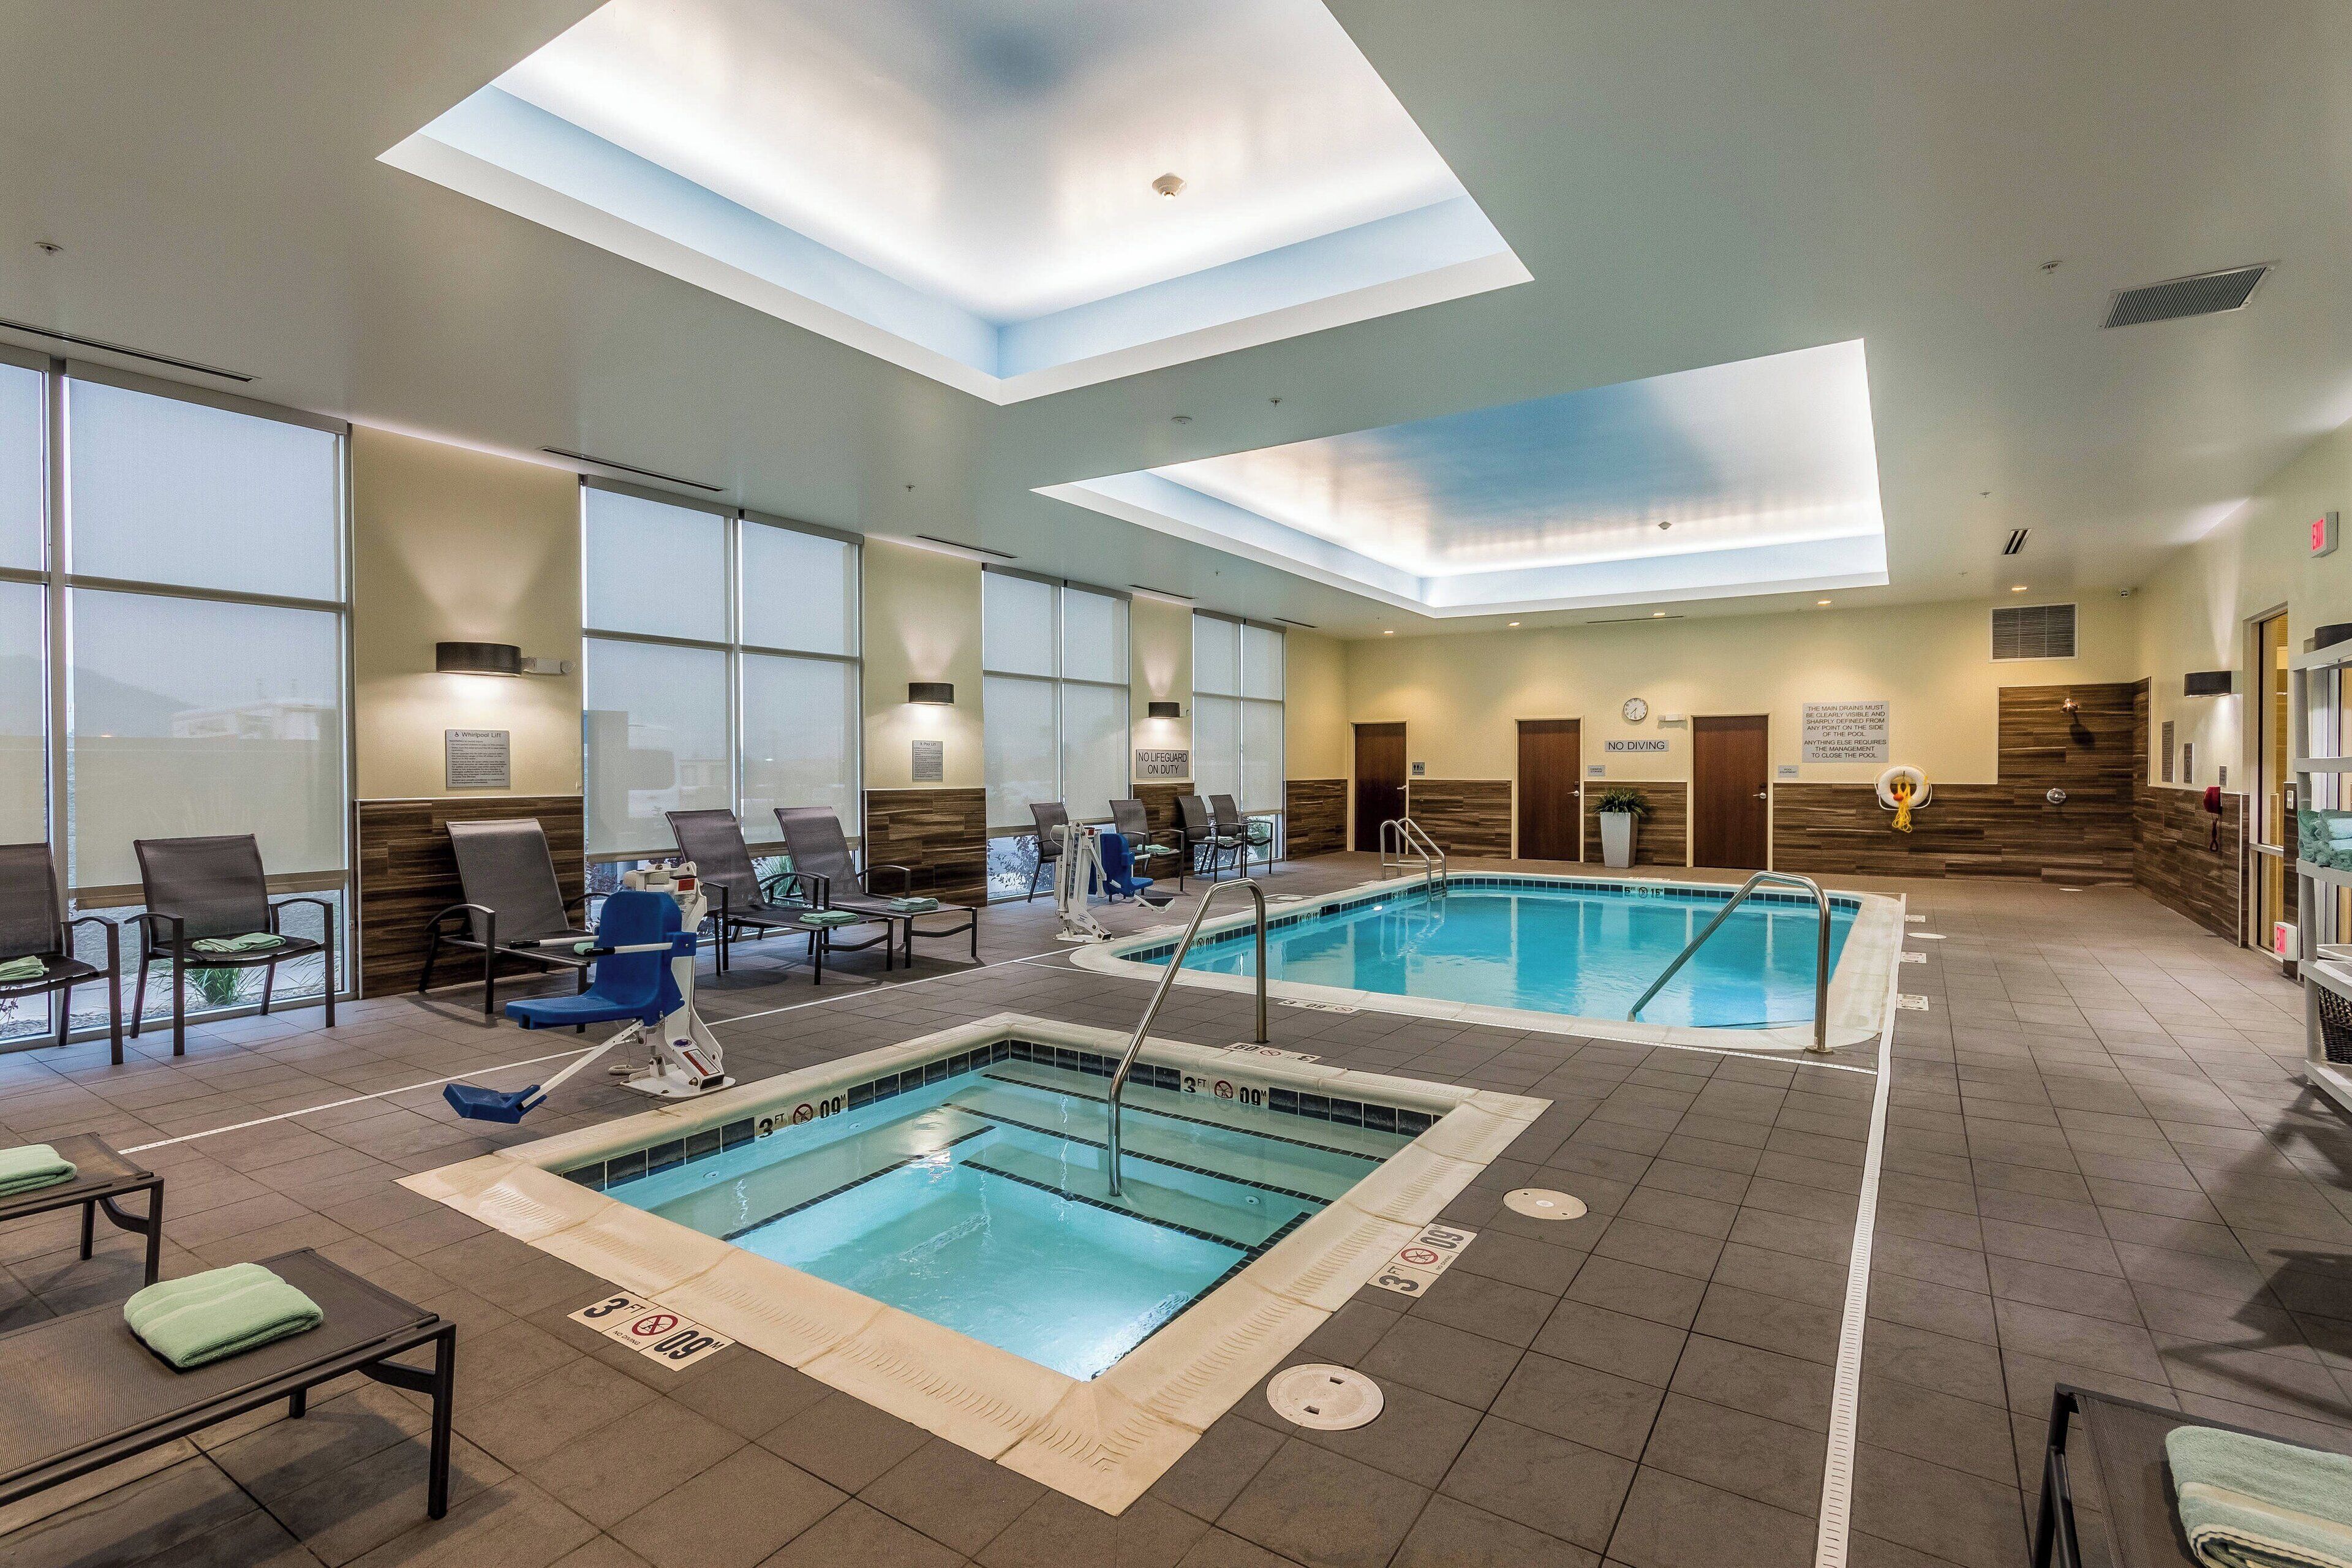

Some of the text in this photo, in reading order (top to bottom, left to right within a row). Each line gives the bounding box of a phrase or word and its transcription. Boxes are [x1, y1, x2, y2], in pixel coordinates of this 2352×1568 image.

[1628, 741, 1665, 750] DIVING
[1139, 752, 1187, 762] NO LIFEGUARD
[1148, 765, 1180, 774] ON DUTY
[621, 1333, 641, 1346] DIVING
